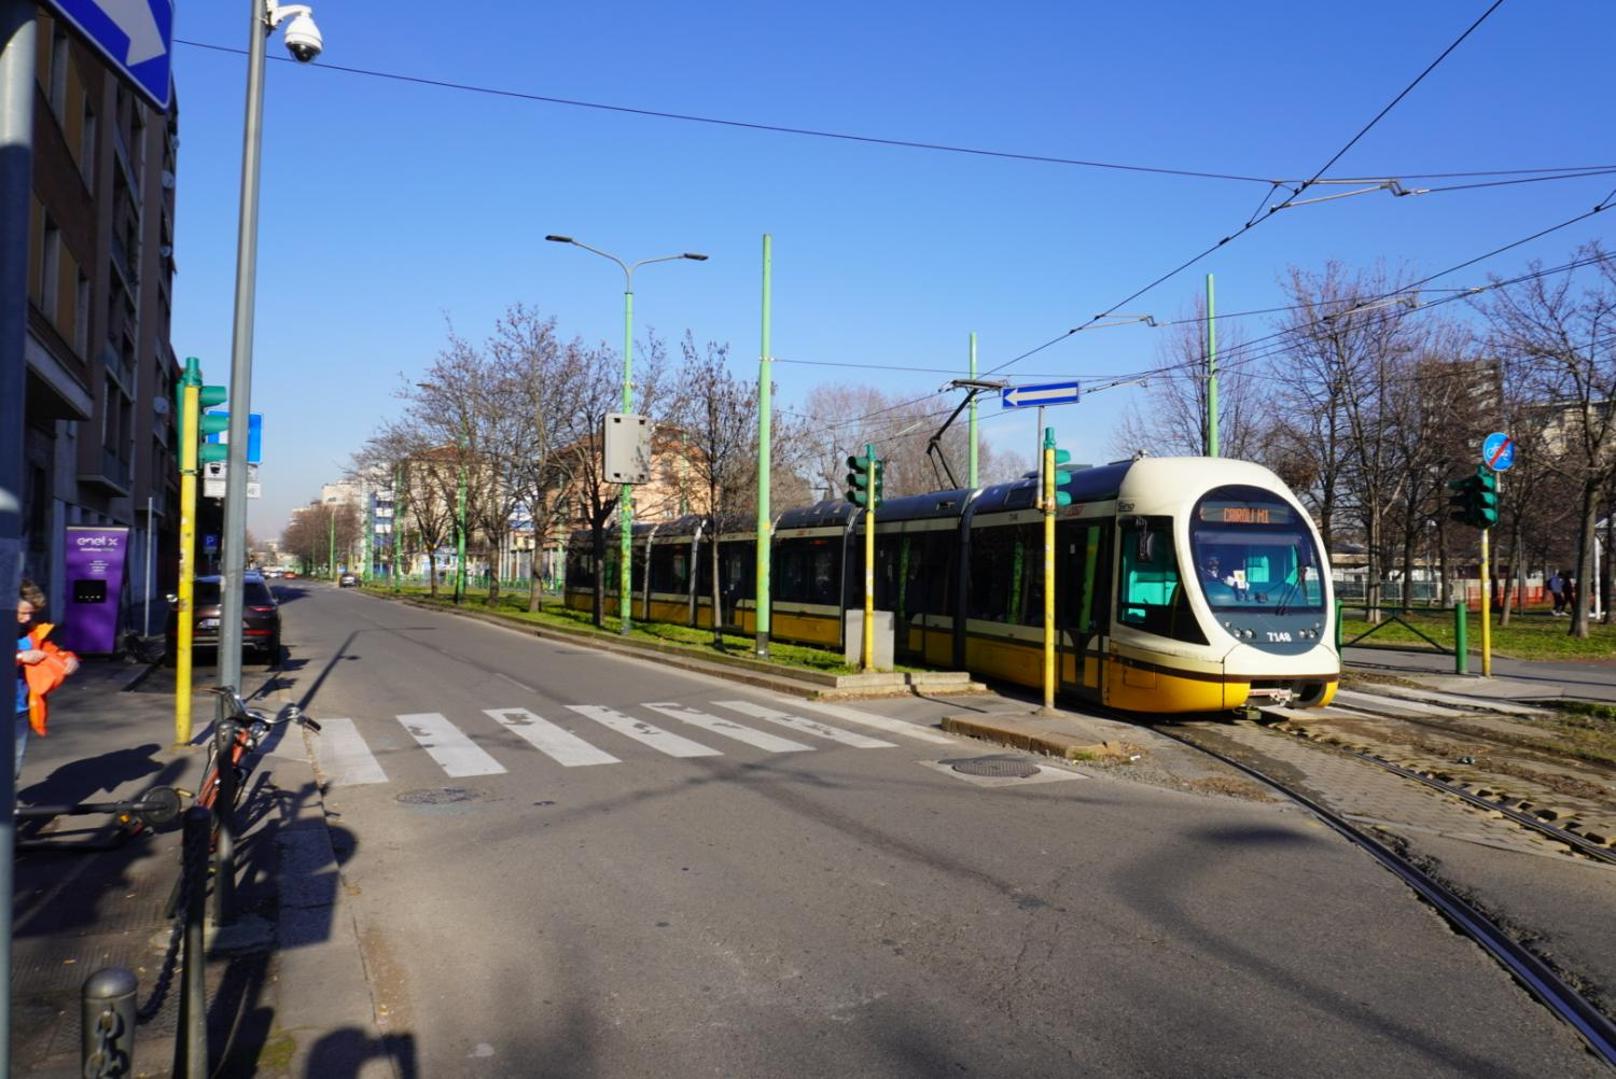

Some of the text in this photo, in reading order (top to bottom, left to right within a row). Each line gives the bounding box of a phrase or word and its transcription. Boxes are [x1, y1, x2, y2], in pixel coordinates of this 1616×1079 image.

[76, 536, 119, 546] enel x
[1266, 631, 1292, 643] 7148
